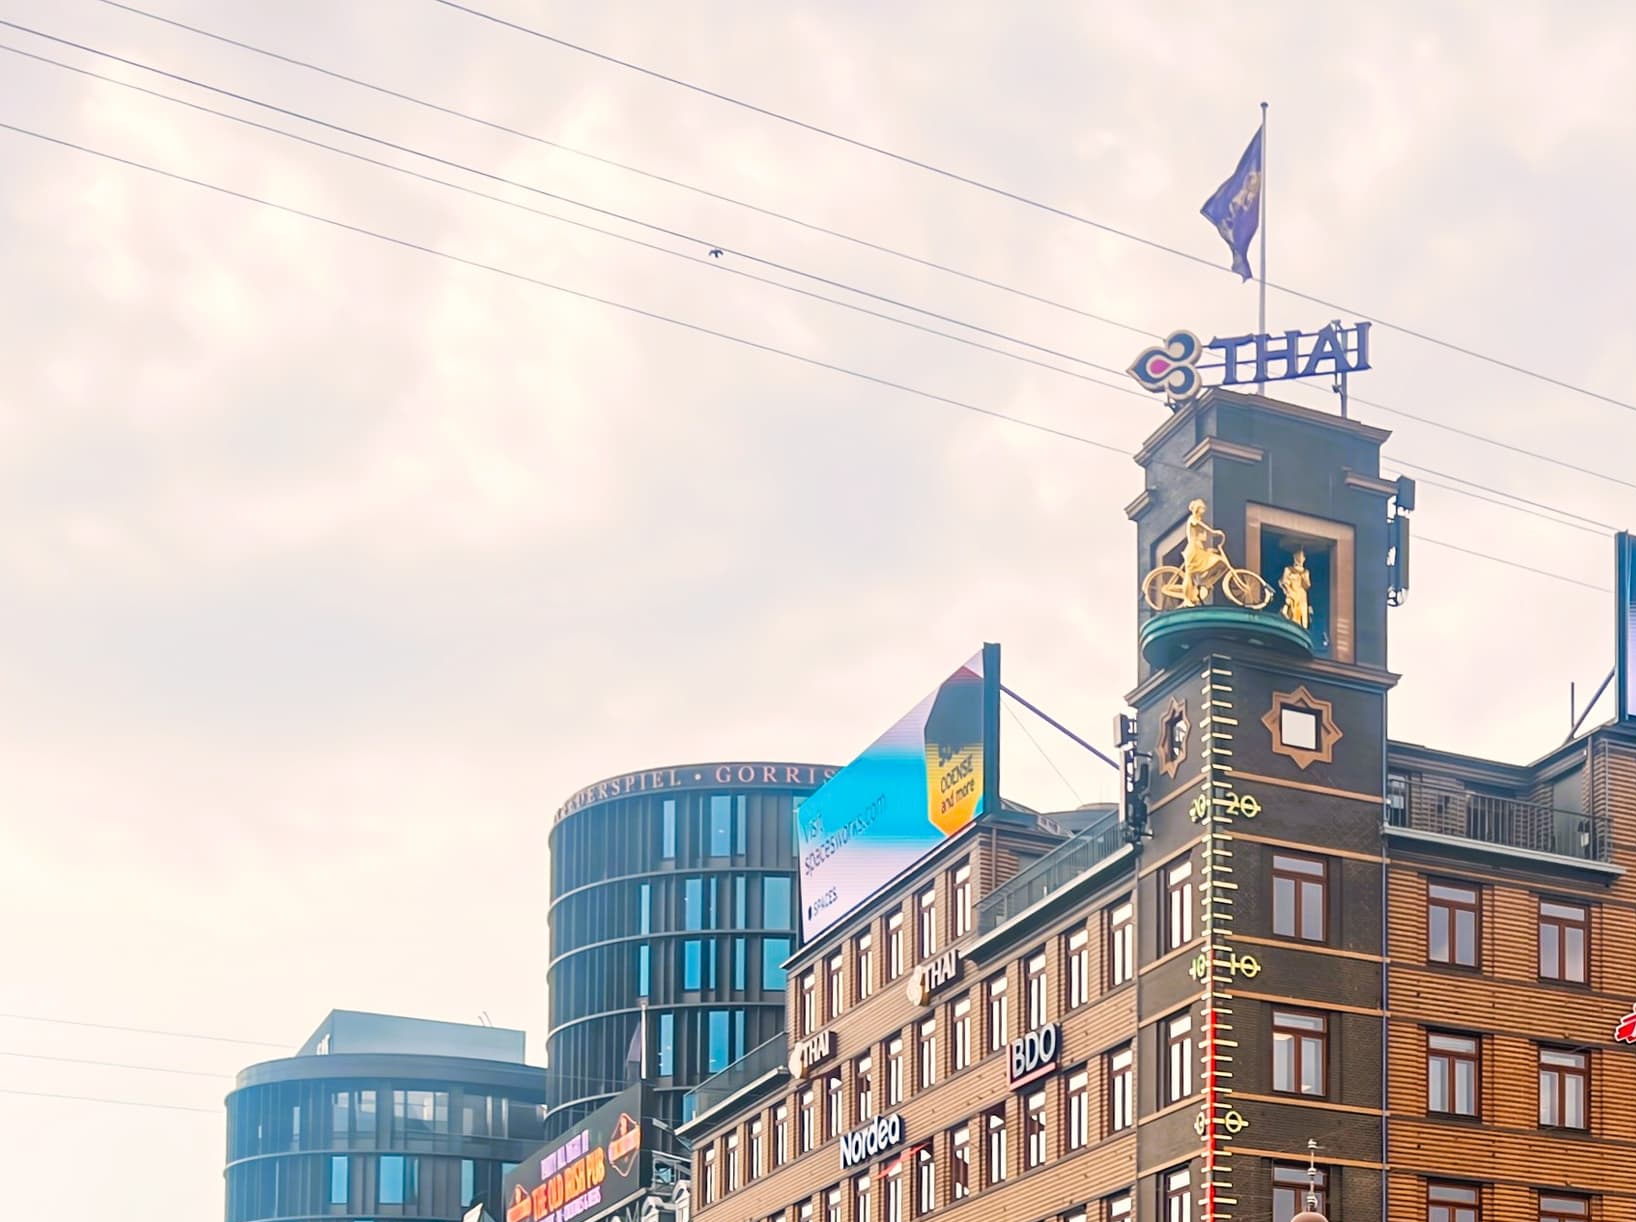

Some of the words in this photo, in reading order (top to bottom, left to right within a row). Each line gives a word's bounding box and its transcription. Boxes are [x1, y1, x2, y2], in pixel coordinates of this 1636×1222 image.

[1208, 320, 1372, 385] THAI
[924, 949, 957, 995] THAI
[801, 1029, 831, 1069] THAI
[1013, 1026, 1058, 1079] BDO
[840, 1113, 901, 1170] Nordea
